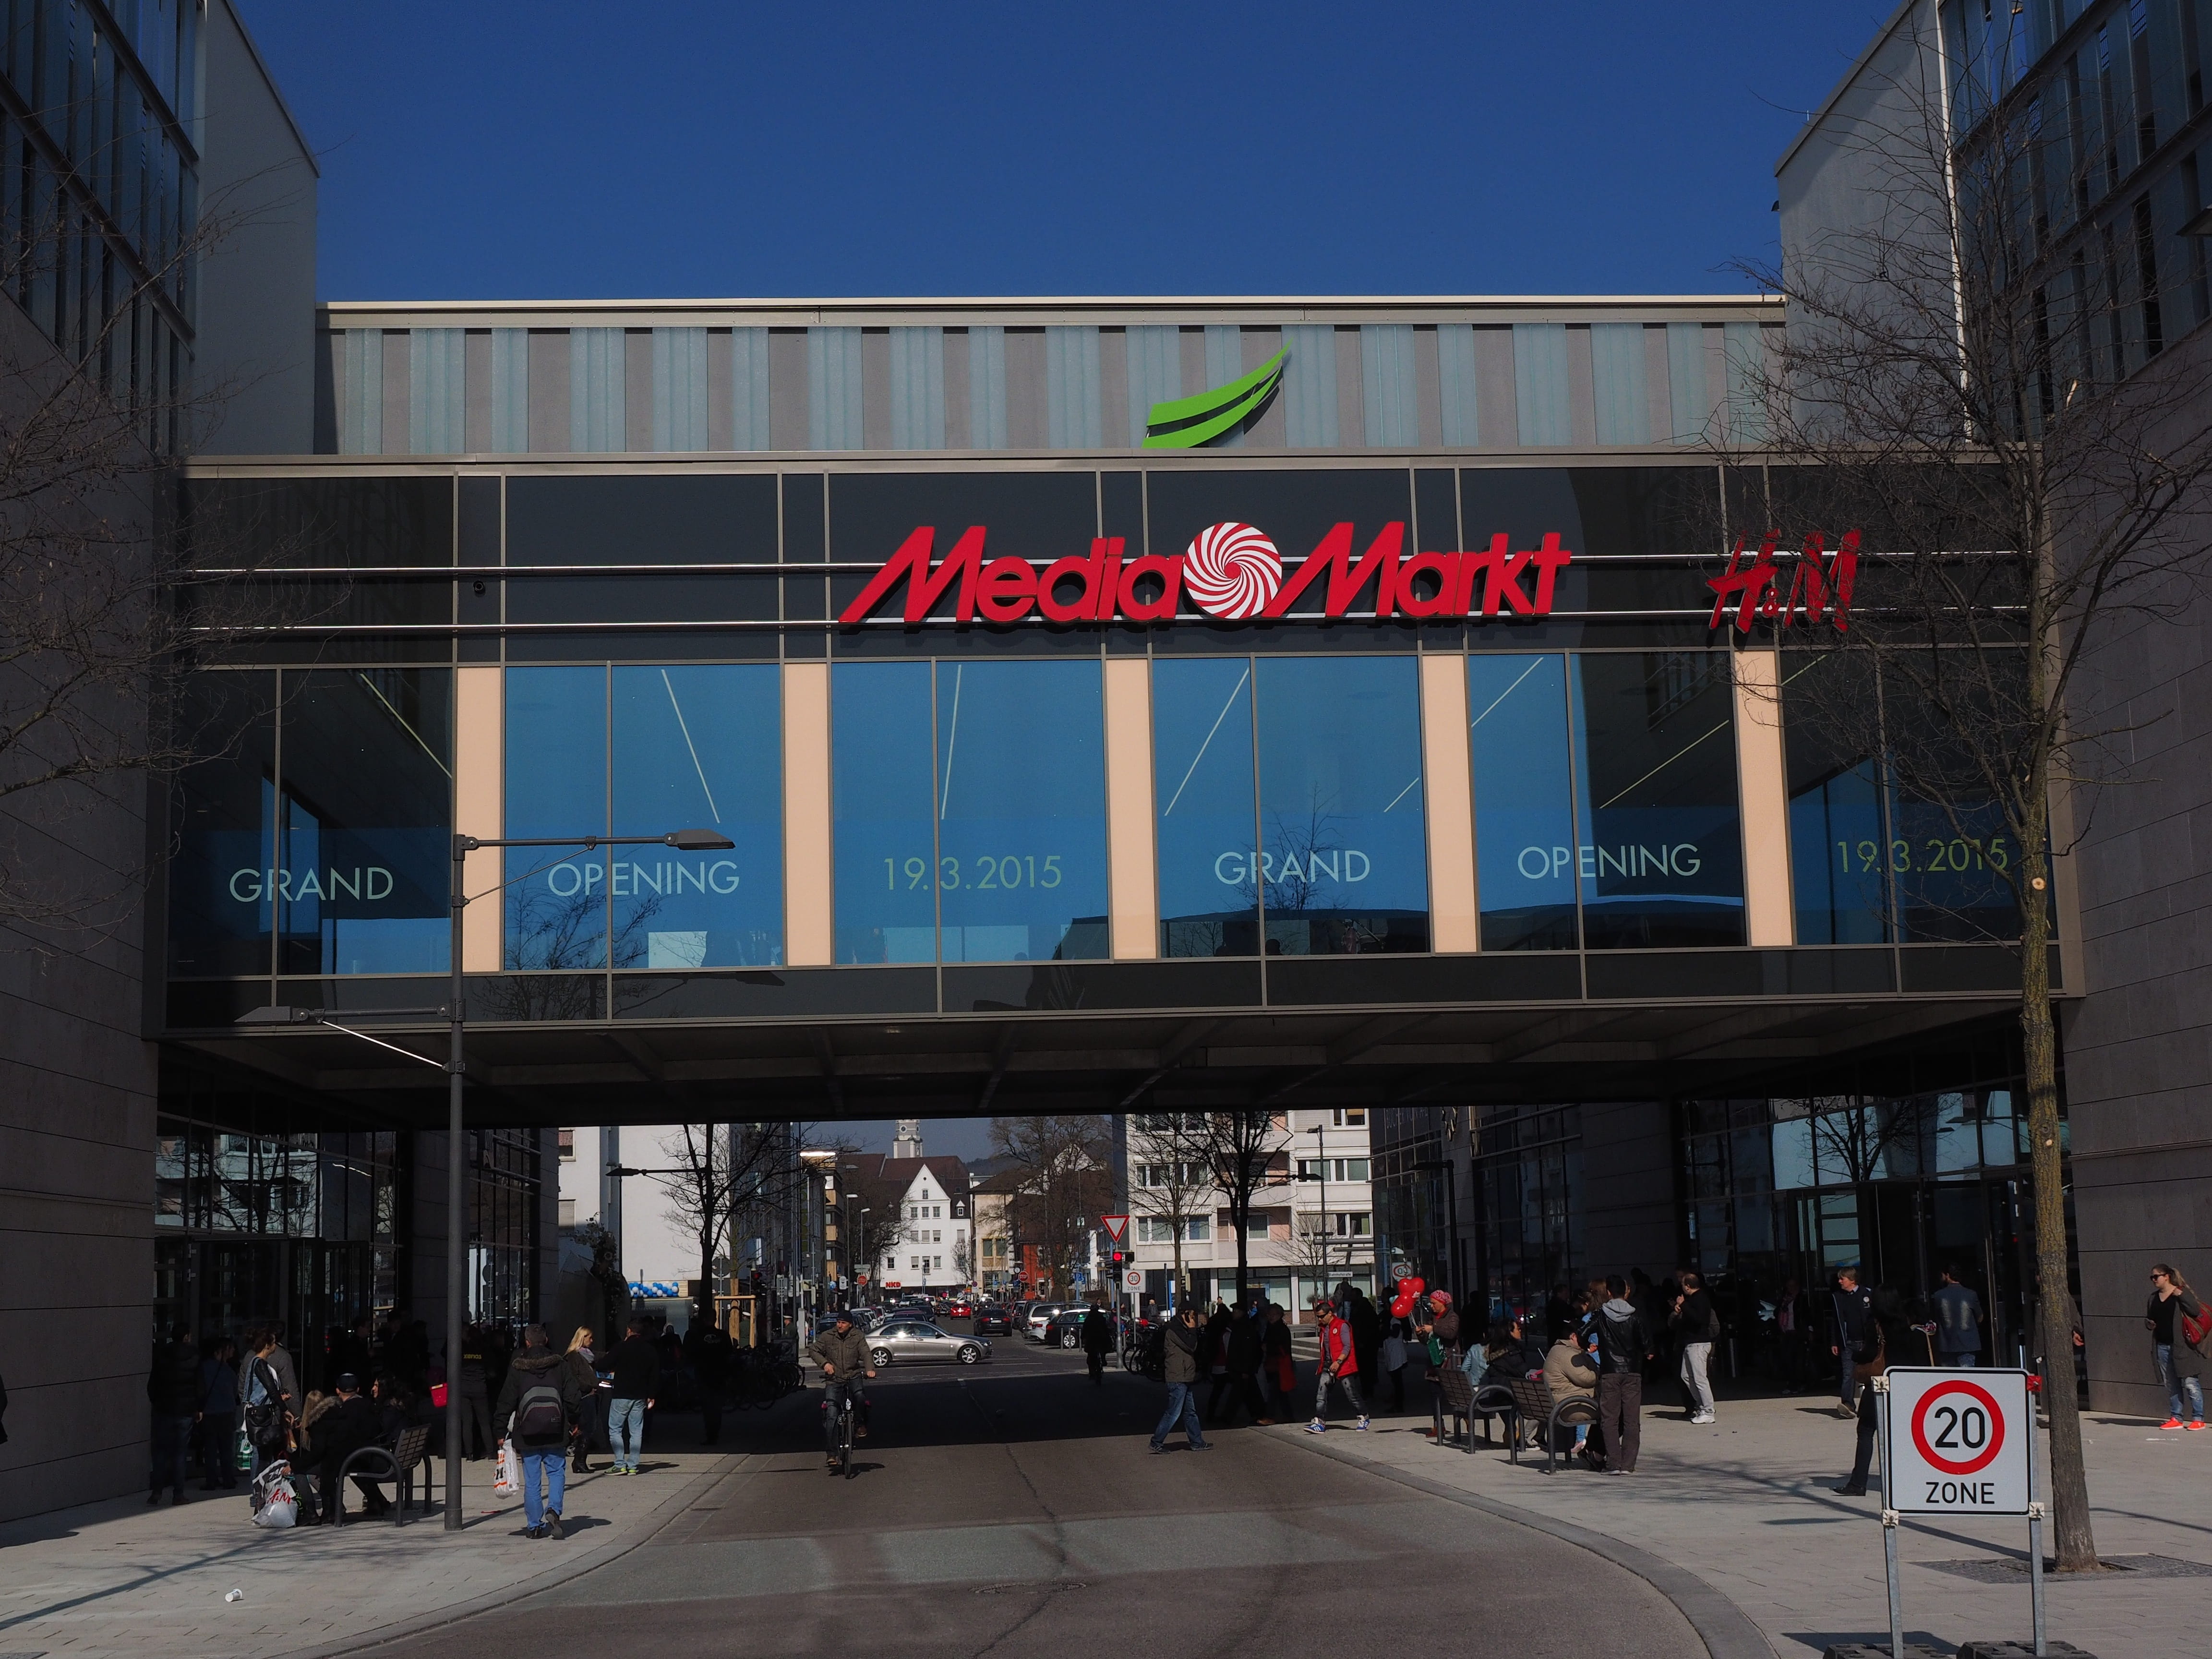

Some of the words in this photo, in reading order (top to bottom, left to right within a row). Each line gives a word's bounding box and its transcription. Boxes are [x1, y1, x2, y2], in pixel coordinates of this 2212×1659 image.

[838, 526, 1184, 623] Media
[1260, 521, 1572, 618] Markt
[1706, 528, 1861, 634] H&M
[229, 867, 394, 902] GRAND
[547, 861, 740, 897] OPENING
[884, 855, 1062, 890] 19.3.2015
[1214, 850, 1370, 885] GRAND
[1517, 843, 1701, 879] OPENING
[1837, 838, 2008, 873] 19.3.2015
[1935, 1407, 1985, 1449] 20
[1926, 1481, 1995, 1504] ZONE
